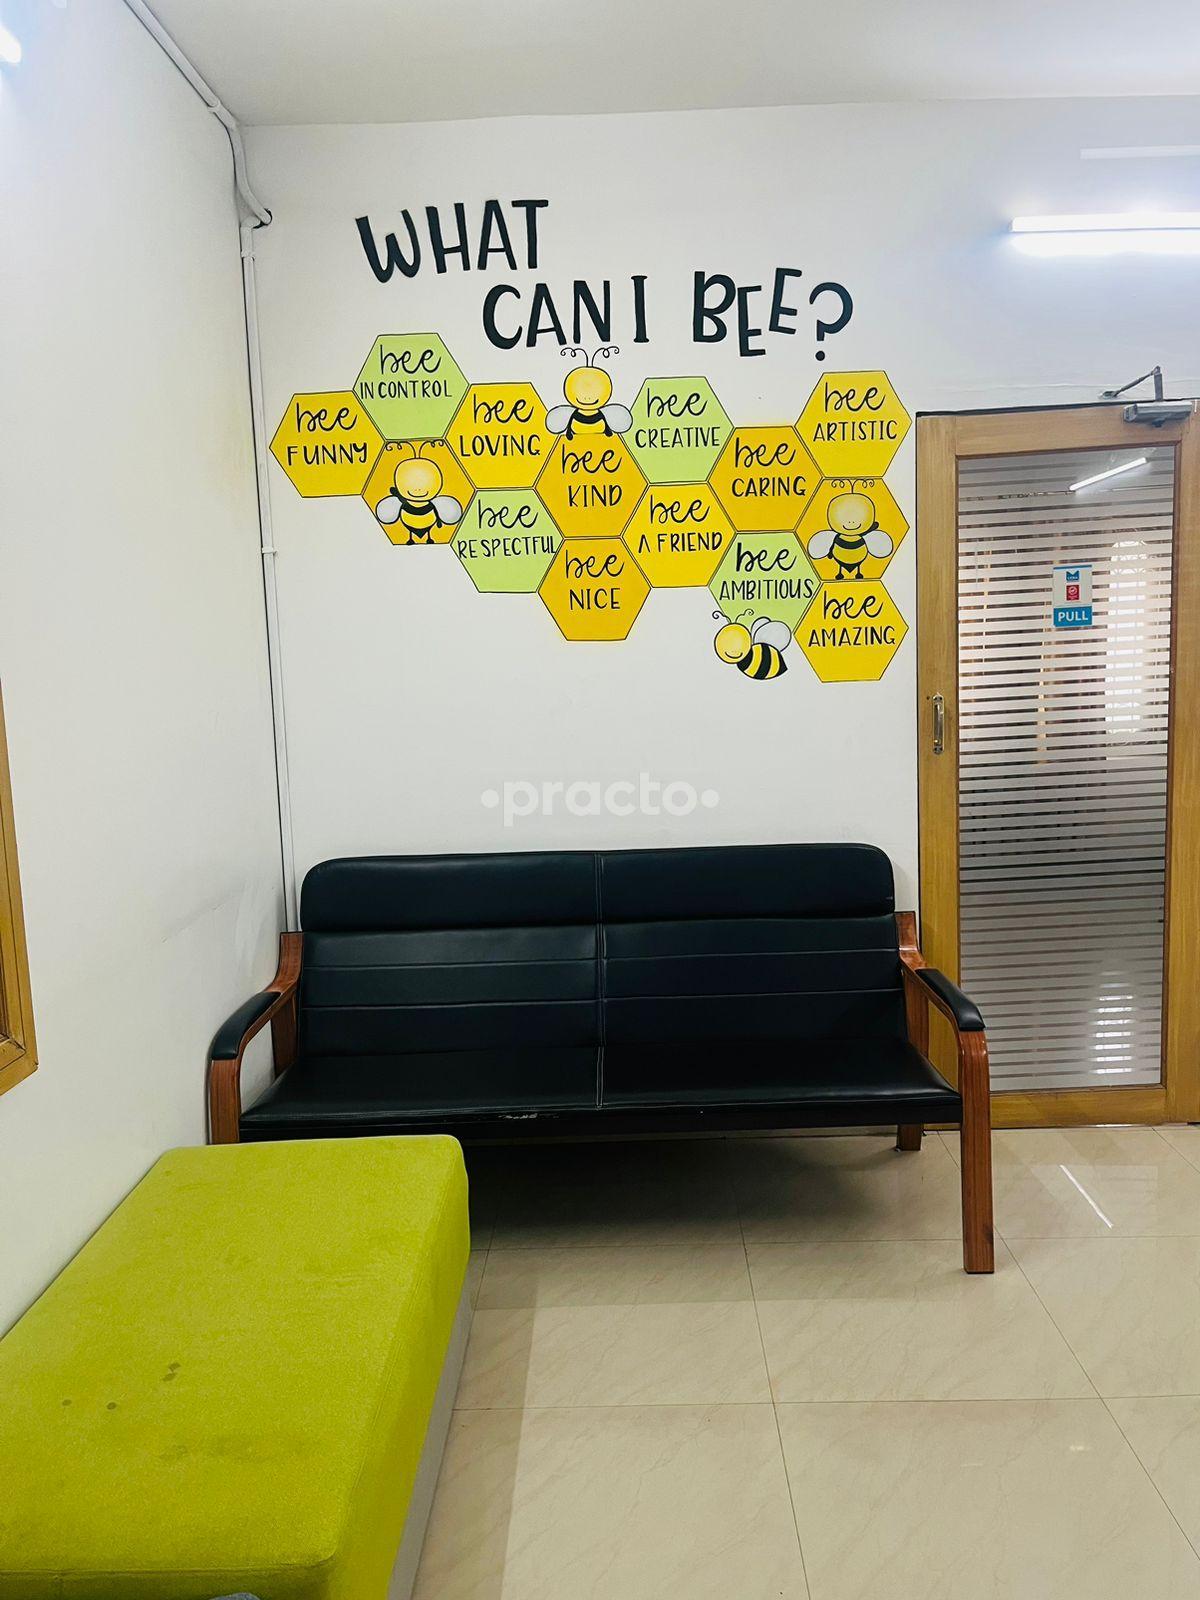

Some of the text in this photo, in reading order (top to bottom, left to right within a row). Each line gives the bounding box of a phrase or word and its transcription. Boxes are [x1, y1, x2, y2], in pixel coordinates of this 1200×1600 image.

[355, 199, 549, 284] WHAT
[482, 267, 854, 361] CAN I BEE?
[379, 344, 442, 375] bee
[359, 379, 453, 399] IN CONTROL
[646, 387, 708, 418] bee
[824, 382, 886, 412] bee
[295, 402, 358, 433] bee
[472, 393, 535, 424] bee
[459, 434, 541, 457] LOVING
[634, 426, 721, 449] CREATIVE
[812, 420, 898, 442] ARTISTIC
[287, 442, 368, 466] FUNNY
[561, 444, 622, 474] bee
[734, 437, 796, 468] bee
[568, 484, 623, 507] KIND
[731, 475, 807, 497] CARING
[477, 499, 539, 529] bee
[649, 494, 710, 524] bee
[457, 535, 557, 559] RESPECTFUL
[638, 531, 723, 554] A FRIEND
[735, 542, 798, 572] bee
[565, 549, 625, 579] bee
[569, 588, 621, 610] NICE
[719, 578, 814, 601] AMBITIOUS
[823, 590, 884, 620] bee
[1057, 610, 1089, 622] PULL
[807, 625, 896, 647] AMAZING
